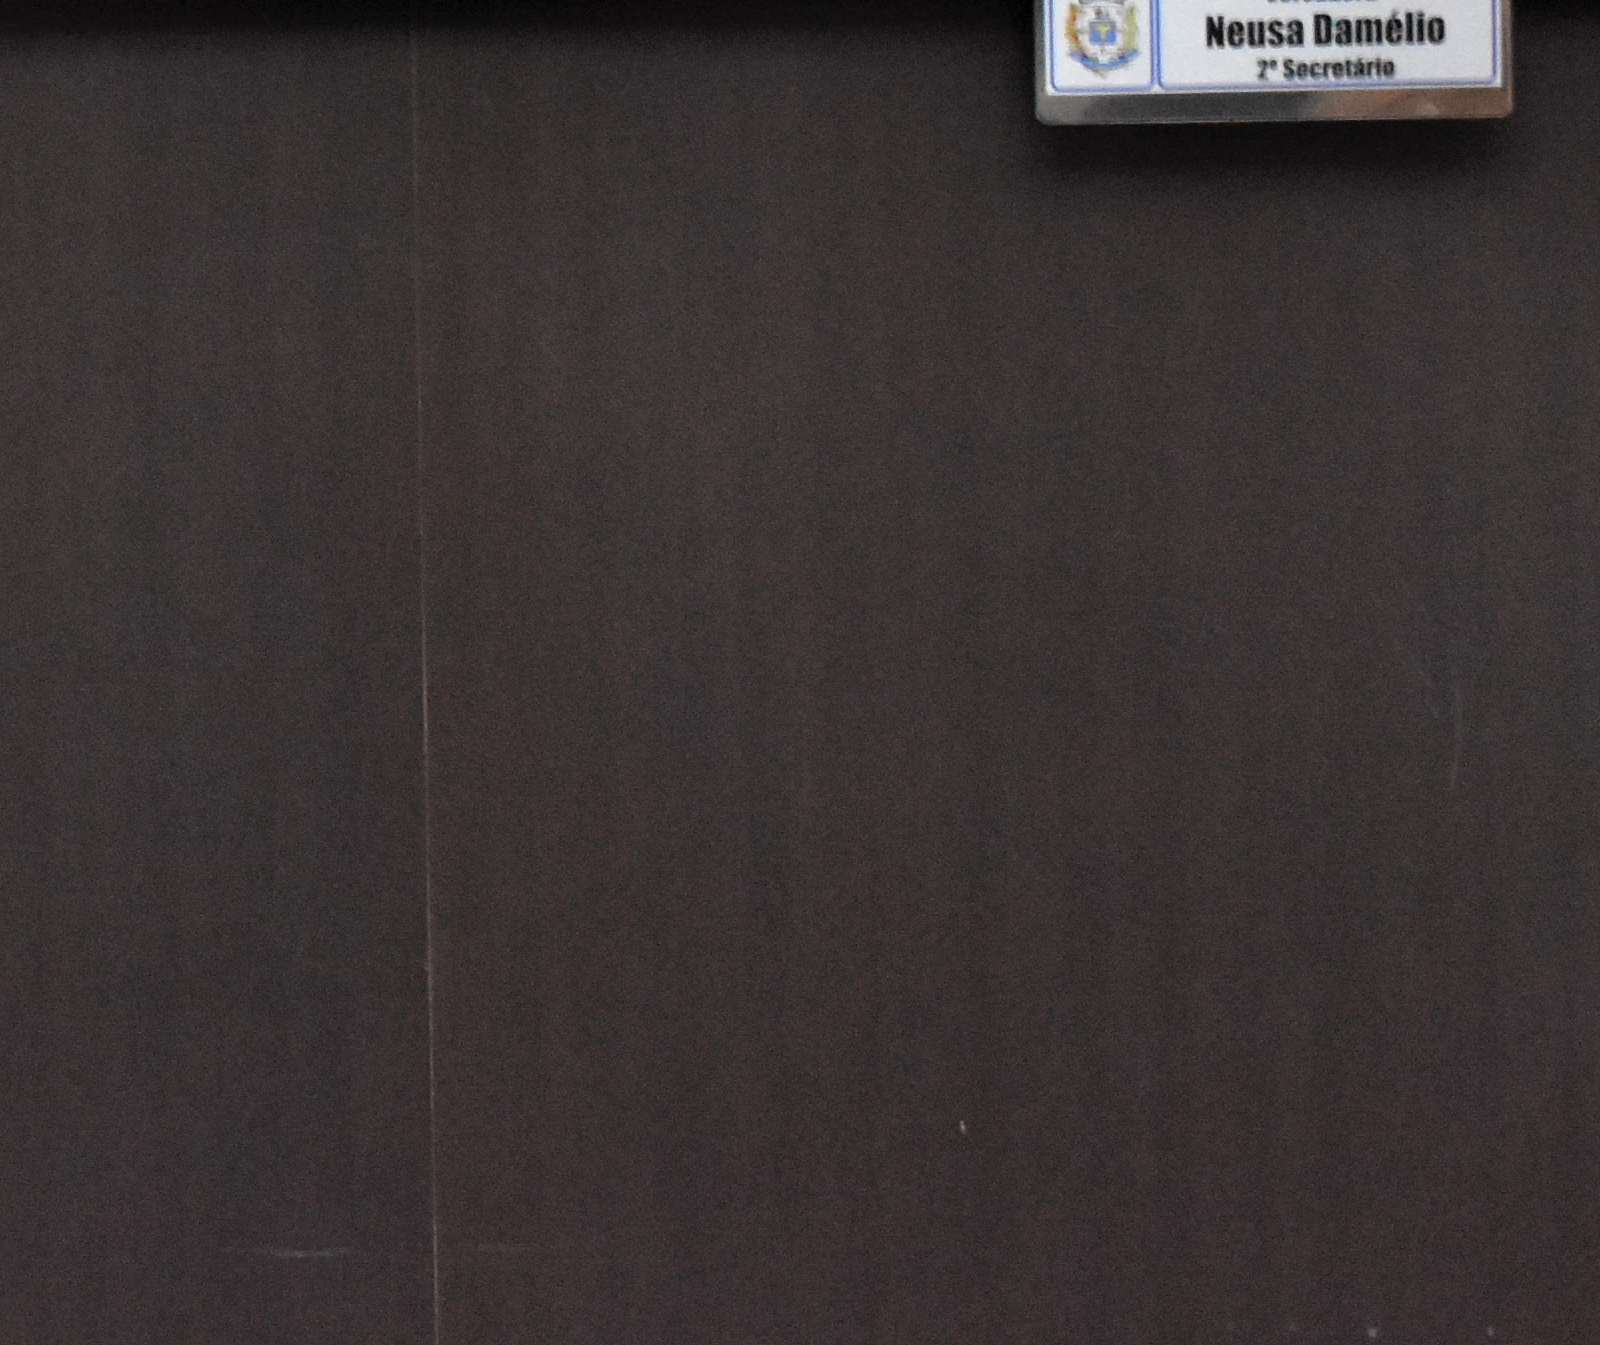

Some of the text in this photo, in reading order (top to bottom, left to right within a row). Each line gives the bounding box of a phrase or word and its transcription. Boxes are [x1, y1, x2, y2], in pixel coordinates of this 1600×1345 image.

[1205, 9, 1446, 49] Neusa Damélio
[1283, 57, 1395, 80] Secretário
